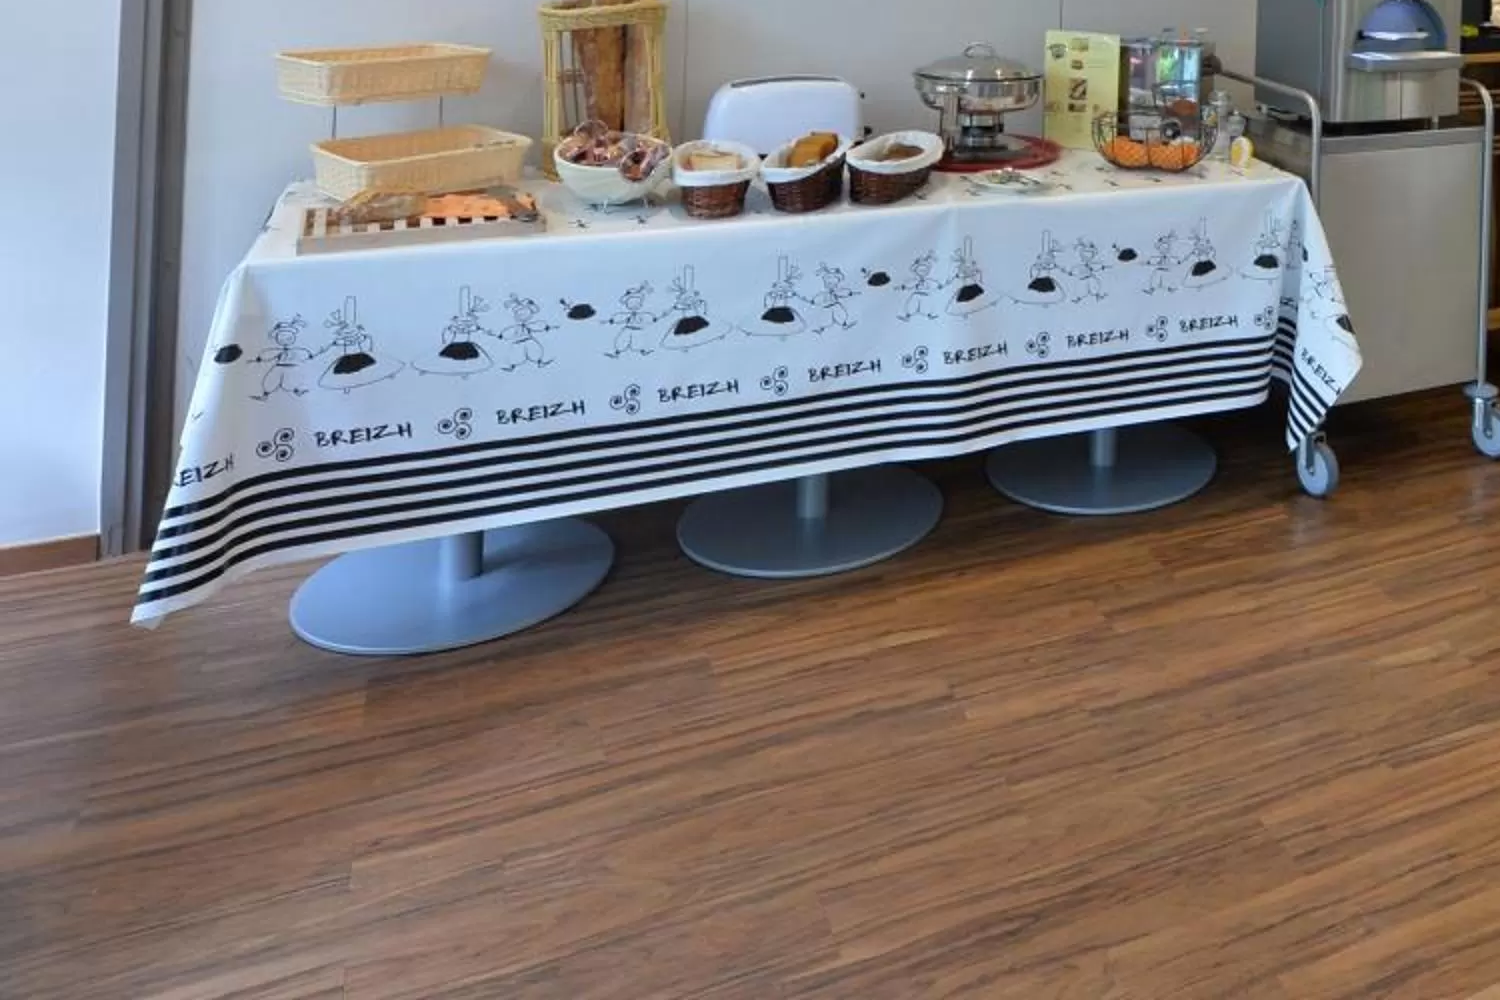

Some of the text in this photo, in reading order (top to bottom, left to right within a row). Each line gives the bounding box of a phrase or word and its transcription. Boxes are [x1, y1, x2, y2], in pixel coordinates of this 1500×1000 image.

[174, 453, 234, 487] EIZH
[314, 422, 412, 448] BREIZH
[496, 400, 586, 425] BREIZH
[657, 379, 740, 403] BREIZH
[808, 359, 882, 382] BREIZH
[943, 343, 1008, 365] BREIZH
[1066, 329, 1130, 348] BREIZH
[1180, 315, 1239, 333] BREIZH
